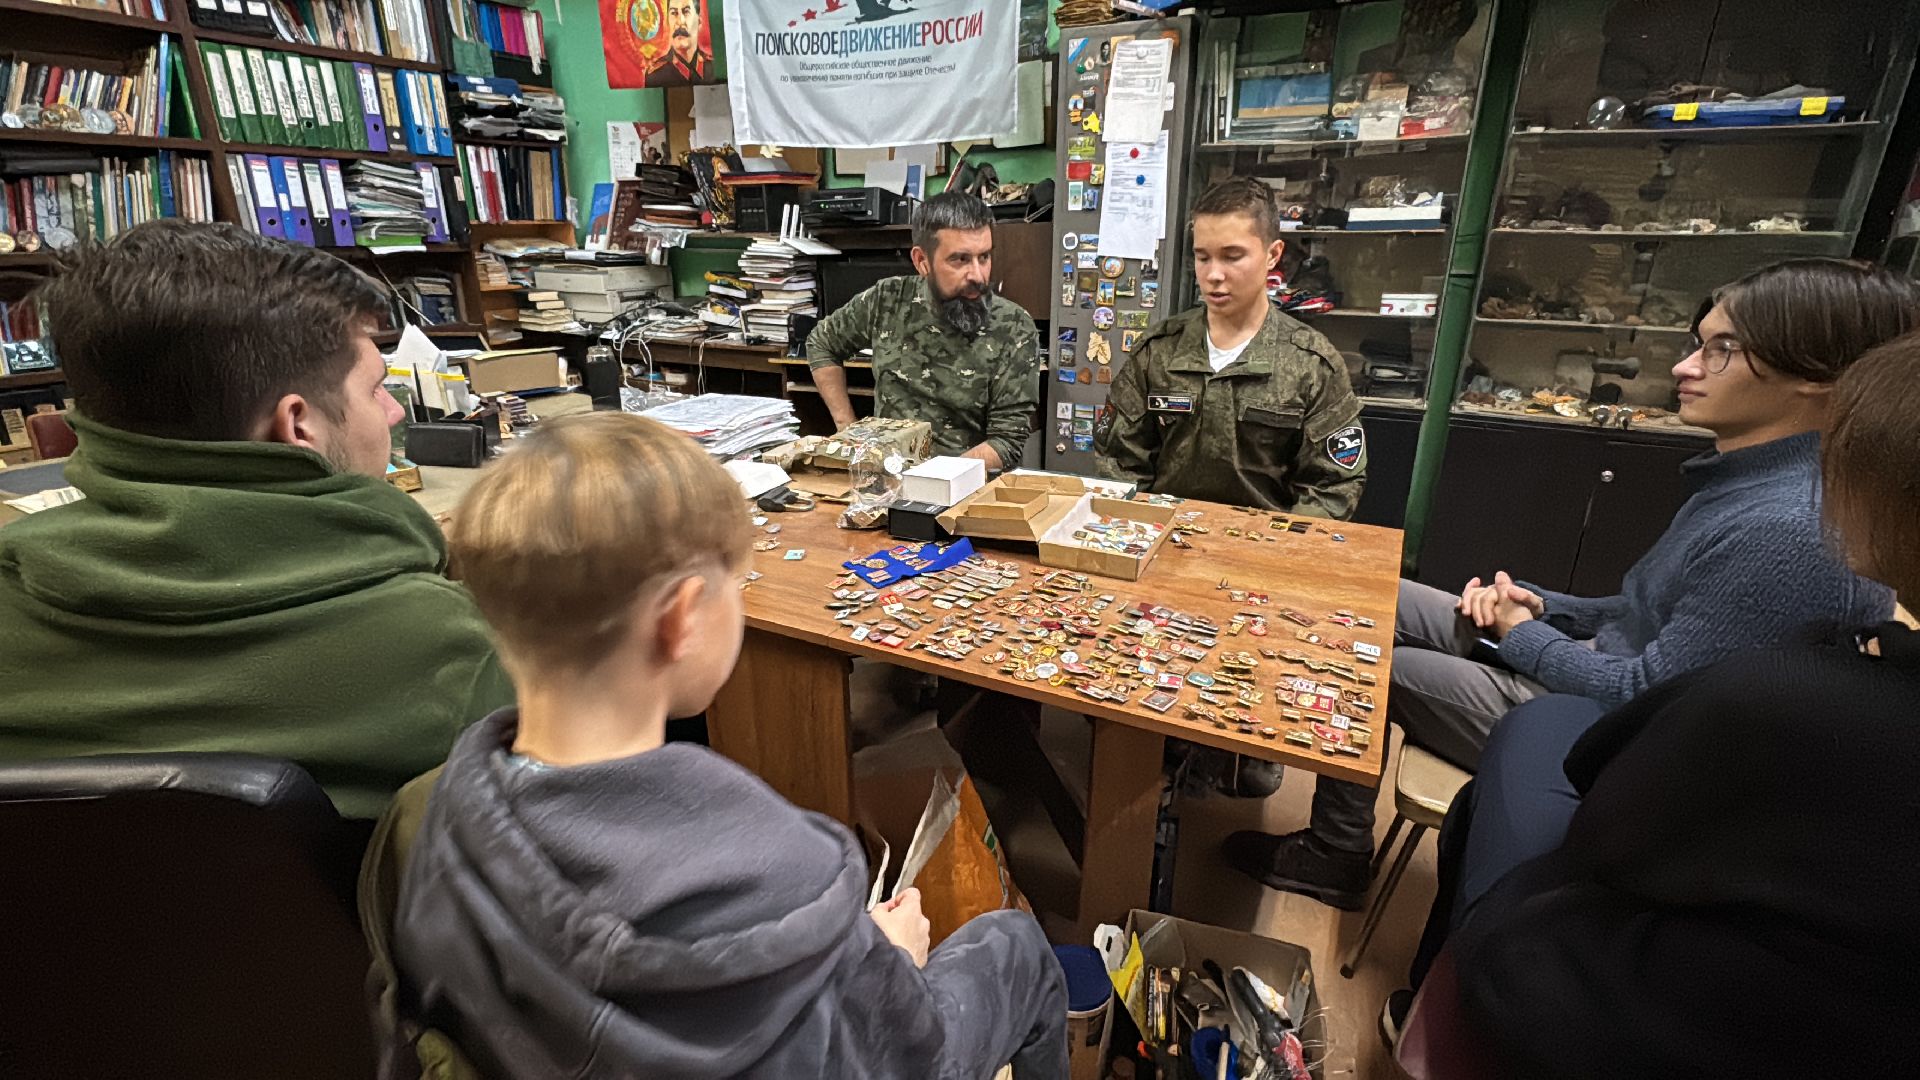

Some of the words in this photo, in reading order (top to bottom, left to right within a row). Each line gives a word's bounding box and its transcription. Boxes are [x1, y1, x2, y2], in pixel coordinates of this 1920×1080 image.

[897, 55, 932, 67] движение
[790, 74, 828, 84] учению
[885, 71, 897, 79] при
[898, 68, 923, 78] защите
